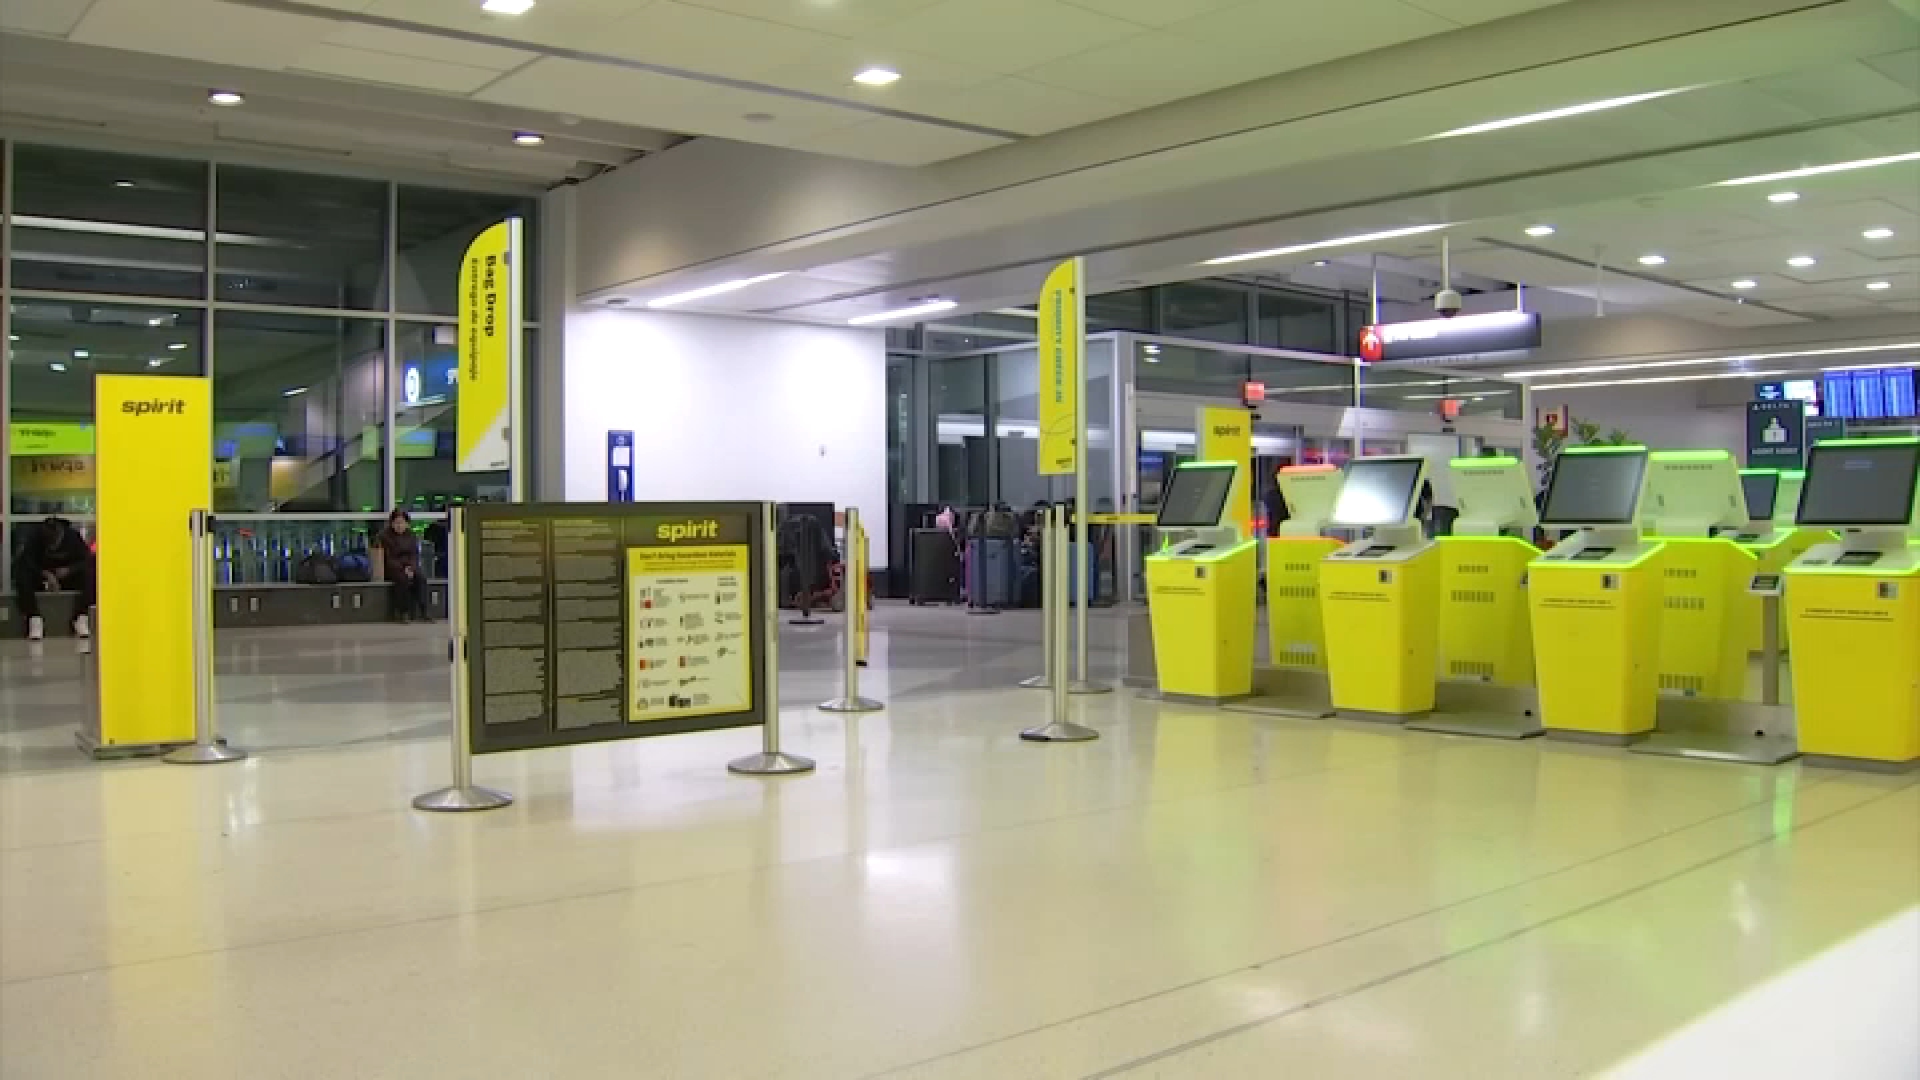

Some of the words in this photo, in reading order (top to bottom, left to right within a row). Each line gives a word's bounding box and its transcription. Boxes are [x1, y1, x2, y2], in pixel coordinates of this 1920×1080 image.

[483, 255, 496, 290] Bag
[483, 293, 496, 337] Drop
[122, 397, 187, 417] spirit
[1212, 424, 1241, 438] spirit
[656, 519, 718, 543] spirit
